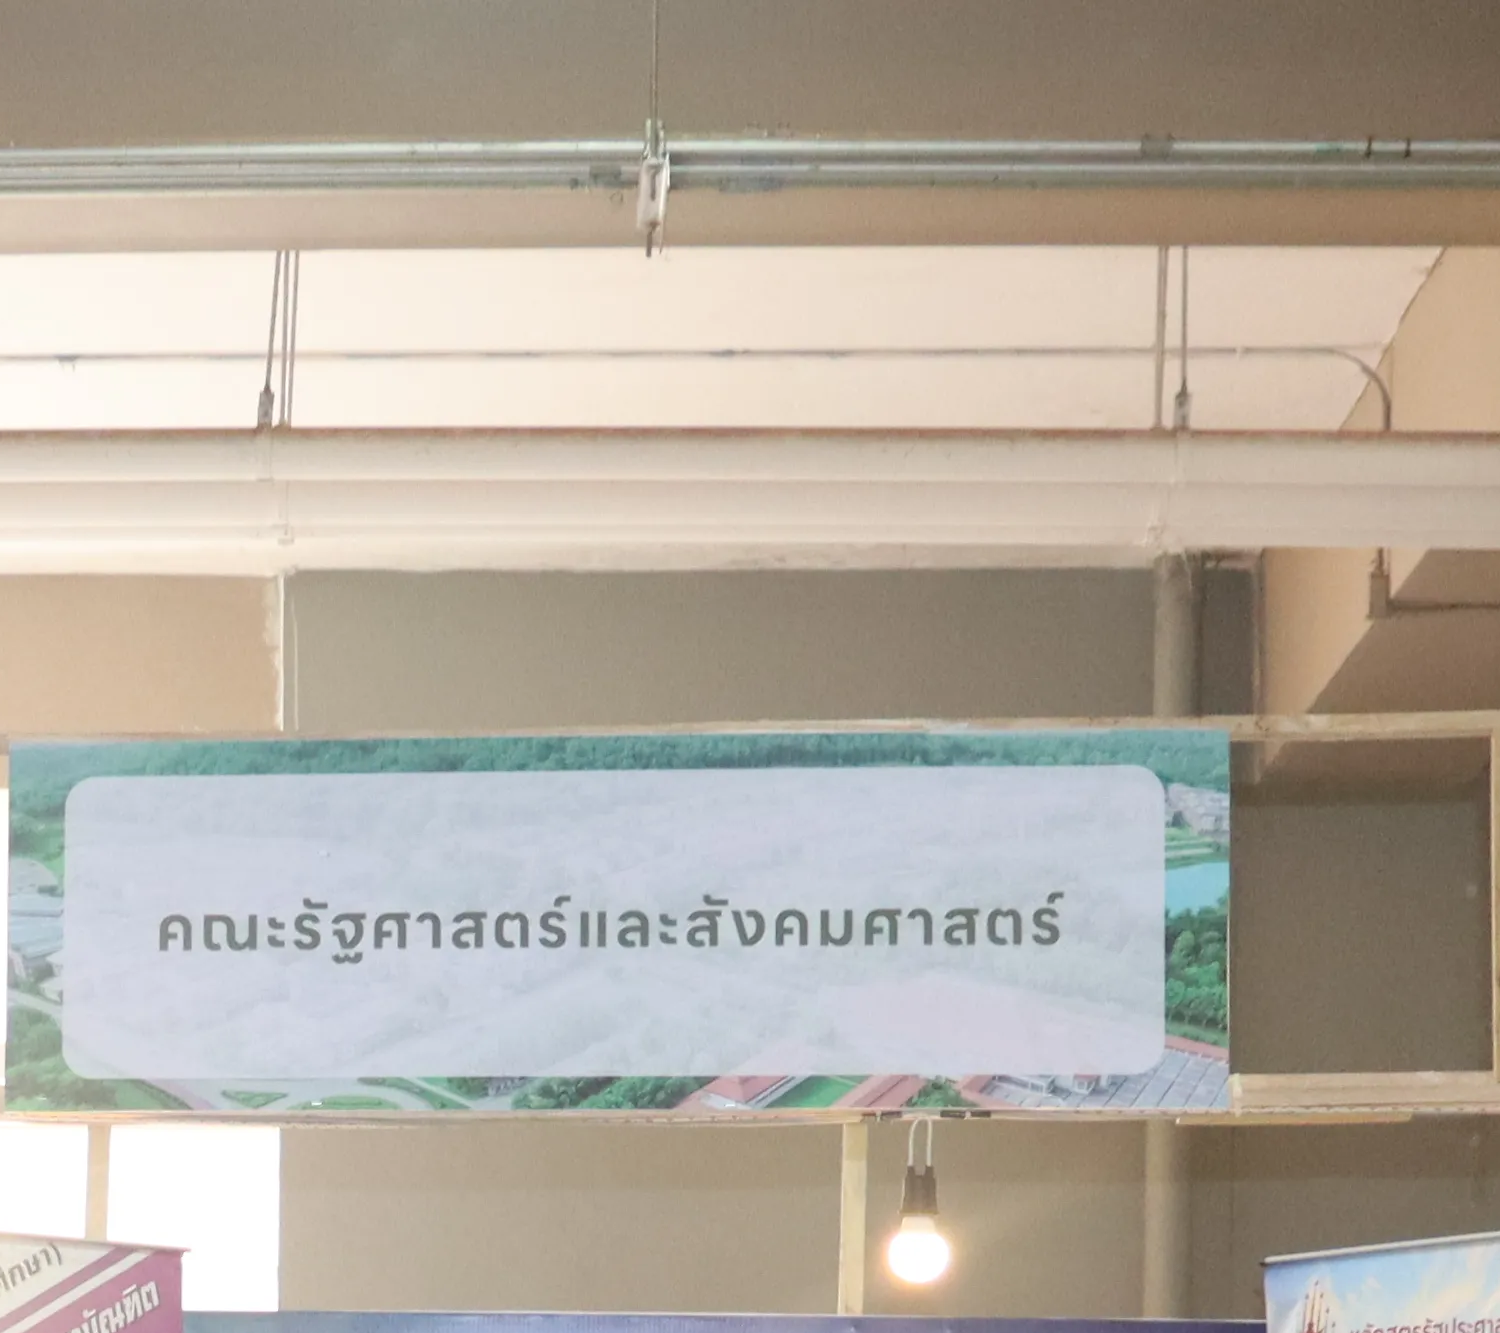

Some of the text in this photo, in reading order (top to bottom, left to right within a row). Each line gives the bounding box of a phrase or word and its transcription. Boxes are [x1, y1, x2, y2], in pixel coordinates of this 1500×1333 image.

[157, 892, 1066, 964] คณะรัฐศาสตร์และสังคมศาสตร์
